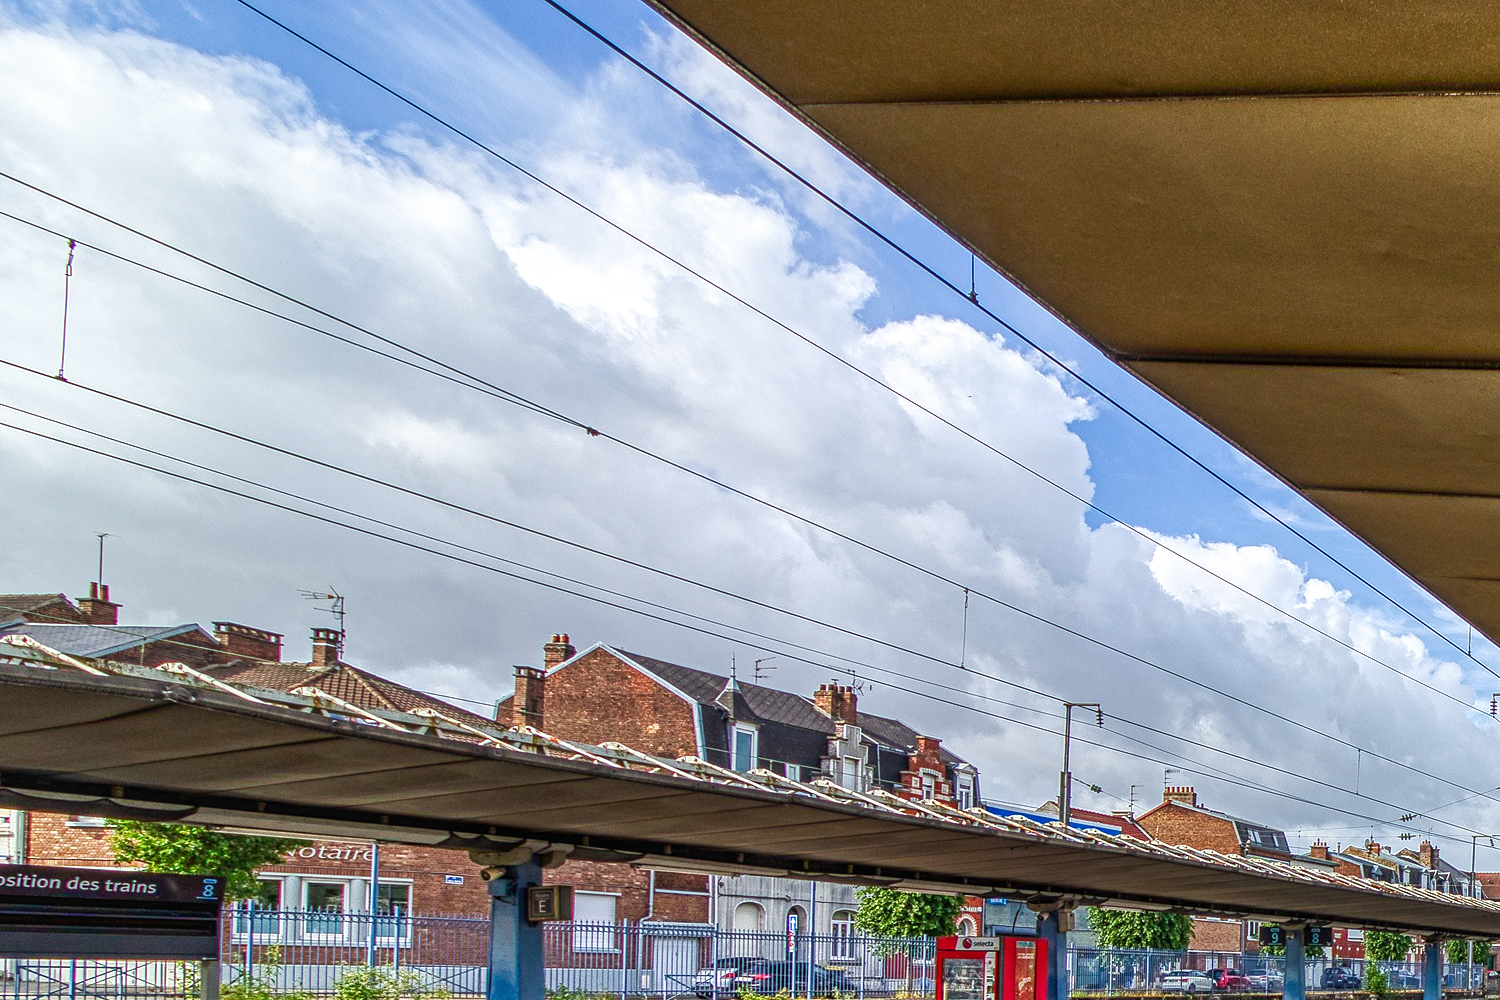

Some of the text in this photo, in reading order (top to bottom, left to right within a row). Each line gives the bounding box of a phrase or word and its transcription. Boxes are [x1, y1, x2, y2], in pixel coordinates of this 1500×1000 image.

[66, 876, 100, 891] des
[105, 878, 157, 894] trains
[203, 884, 214, 897] 8
[539, 900, 546, 913] E
[1271, 932, 1279, 943] 9
[1312, 933, 1320, 944] 8
